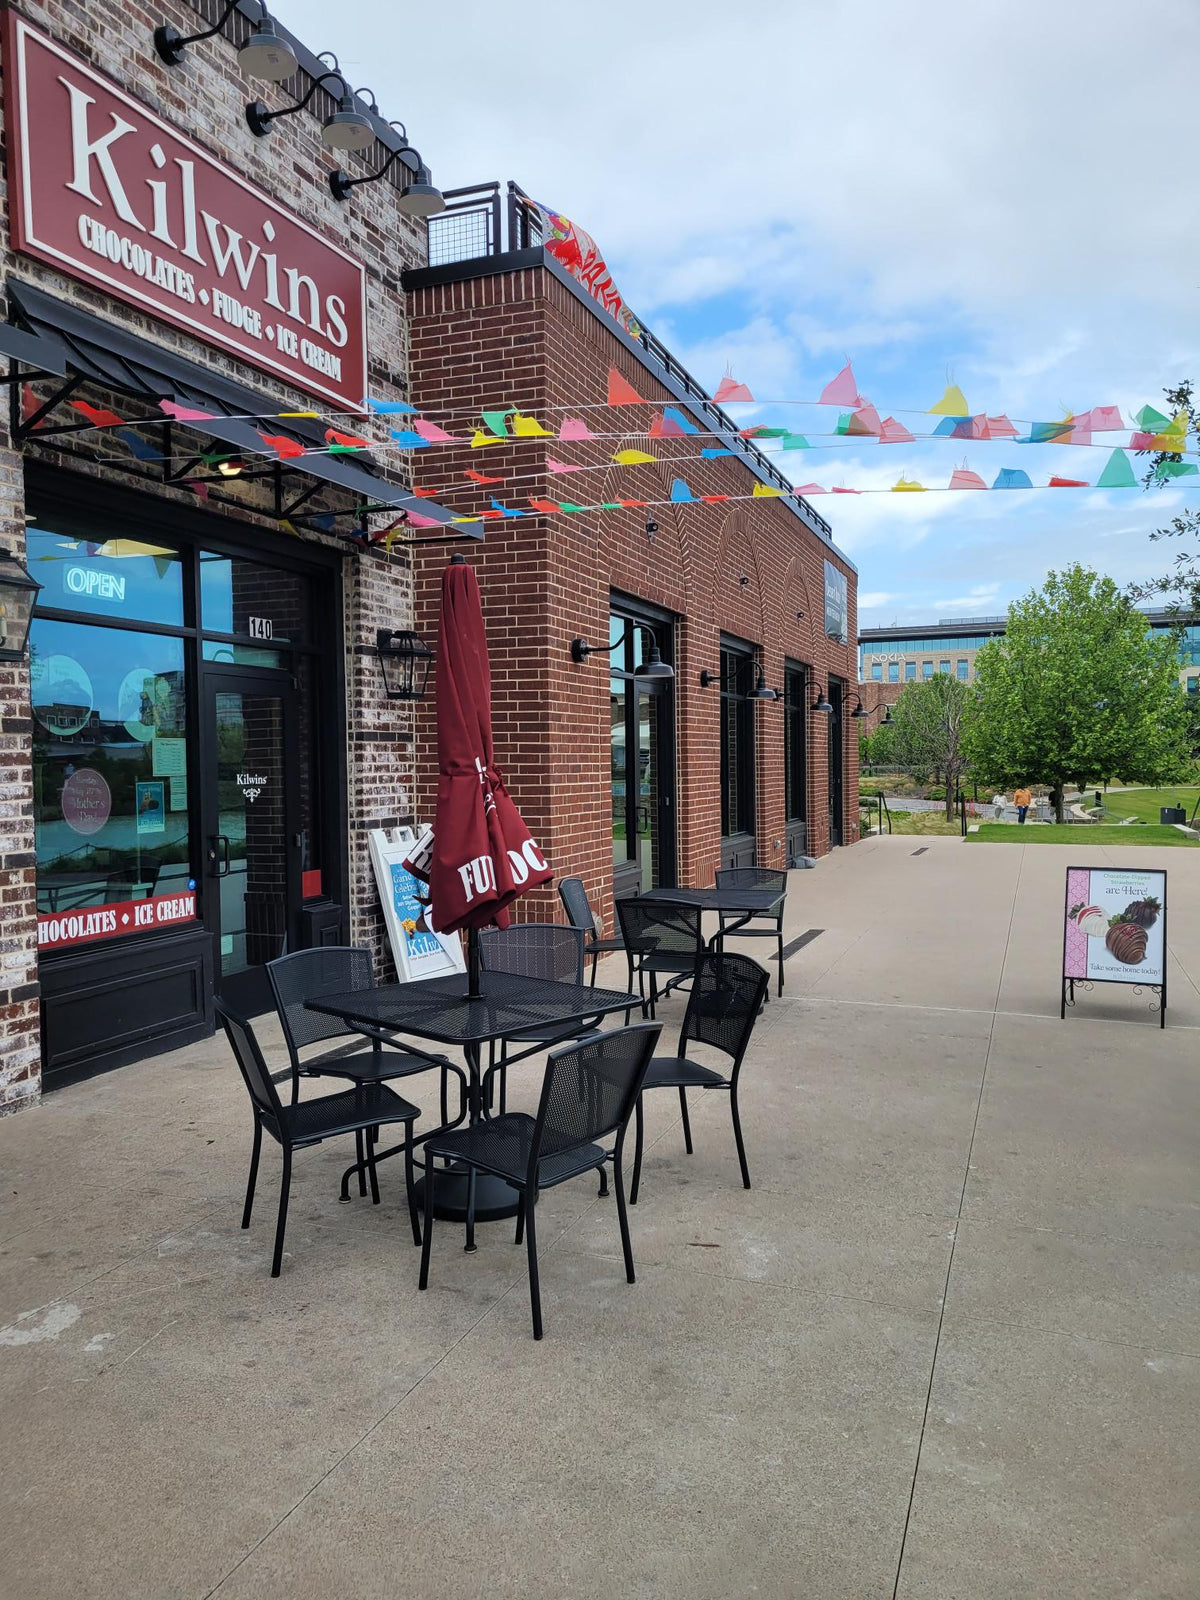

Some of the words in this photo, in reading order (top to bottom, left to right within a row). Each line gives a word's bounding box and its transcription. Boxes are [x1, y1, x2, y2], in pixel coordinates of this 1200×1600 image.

[58, 76, 349, 348] Kilwins
[78, 214, 196, 304] CHOCOLATES
[212, 287, 262, 340] FUDGE
[276, 323, 299, 360] ICE
[300, 338, 342, 383] CREAM
[67, 567, 126, 600] OPEN
[250, 618, 272, 640] 140
[871, 653, 906, 663] NOKIA
[236, 773, 268, 785] Kilwins
[1105, 886, 1121, 895] are
[37, 910, 117, 945] HOCOLATES
[134, 904, 154, 926] ICE
[156, 896, 195, 922] CREAM
[1122, 966, 1140, 974] home
